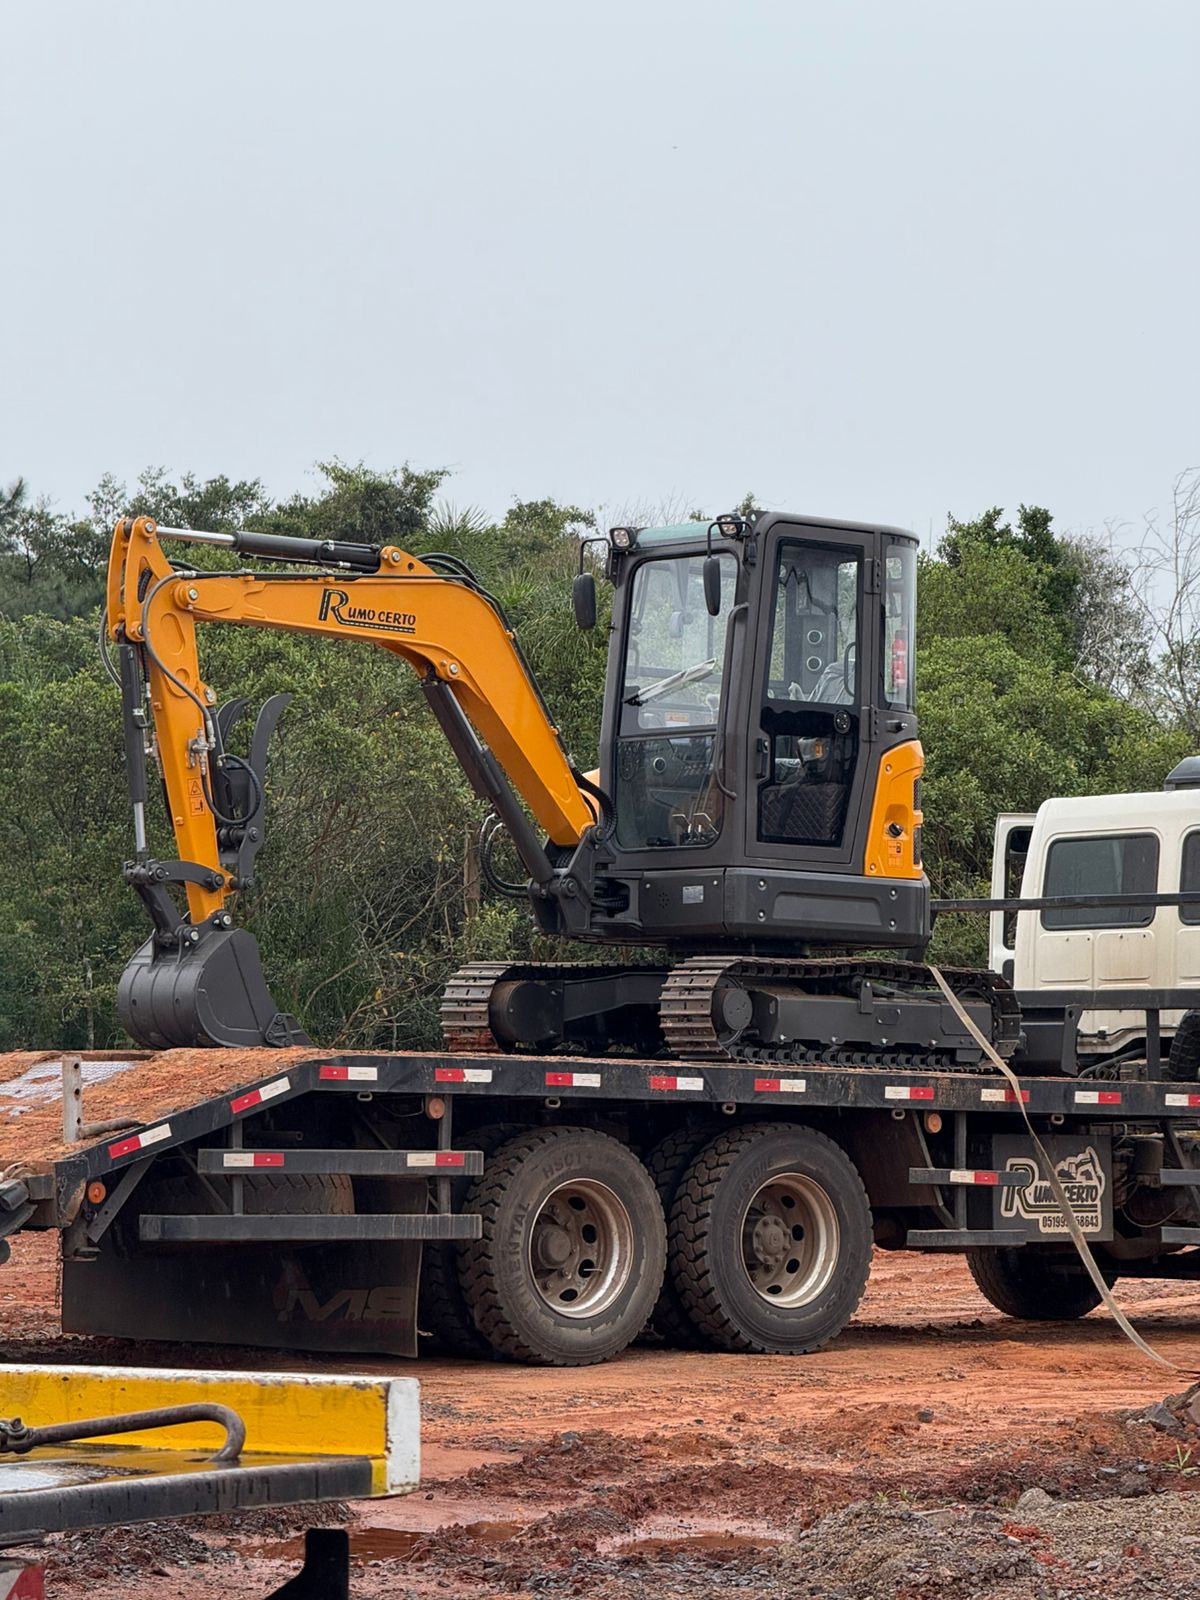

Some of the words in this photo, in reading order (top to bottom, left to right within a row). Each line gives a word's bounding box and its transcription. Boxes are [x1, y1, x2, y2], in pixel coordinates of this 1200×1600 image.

[378, 611, 416, 626] CERTO
[1003, 1163, 1060, 1213] RUM
[1063, 1184, 1099, 1204] CERTO
[1042, 1215, 1099, 1229] 0519958643
